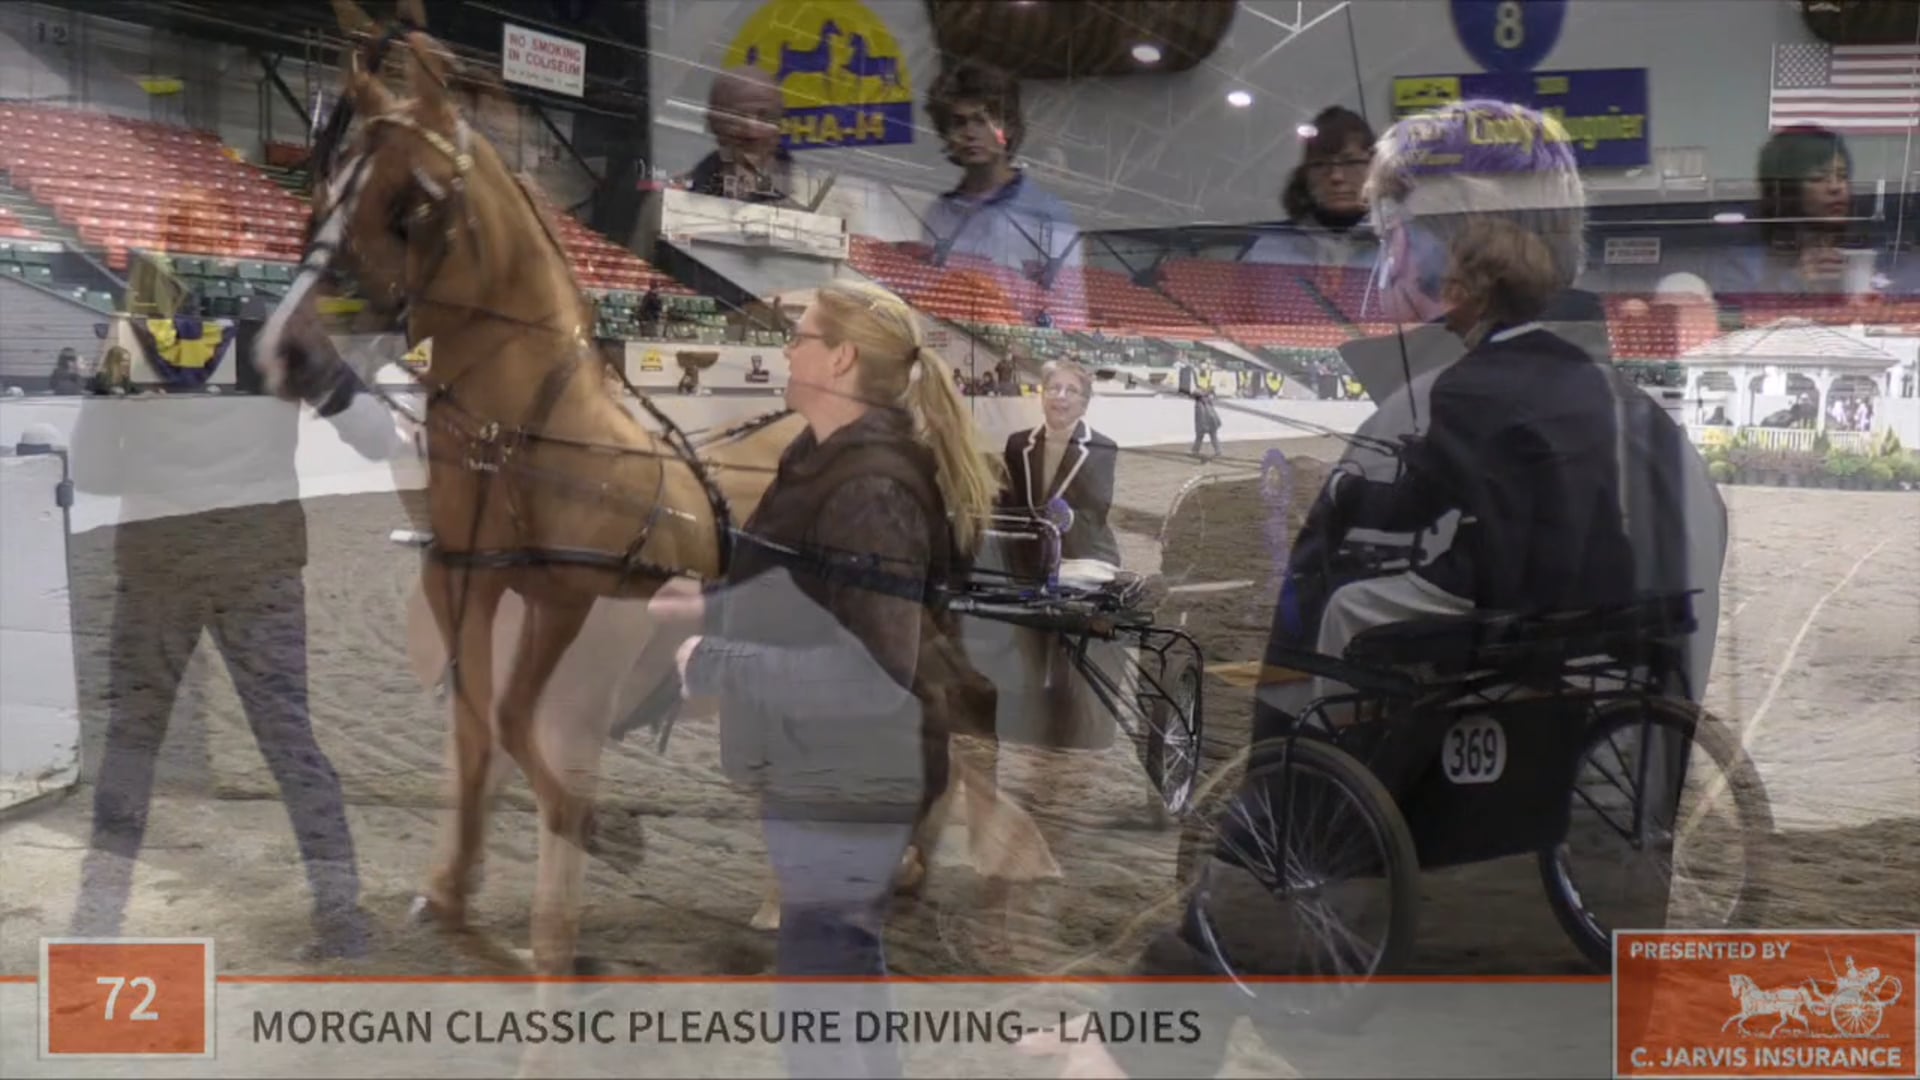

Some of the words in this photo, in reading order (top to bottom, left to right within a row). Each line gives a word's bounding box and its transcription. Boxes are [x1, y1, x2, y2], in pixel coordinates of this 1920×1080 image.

[1494, 1, 1525, 49] 8
[508, 32, 526, 48] NO
[532, 37, 581, 62] SMOKING
[508, 48, 520, 62] IN
[525, 51, 581, 76] COLISEUM
[778, 111, 886, 144] PHA-14
[1450, 727, 1498, 777] 369
